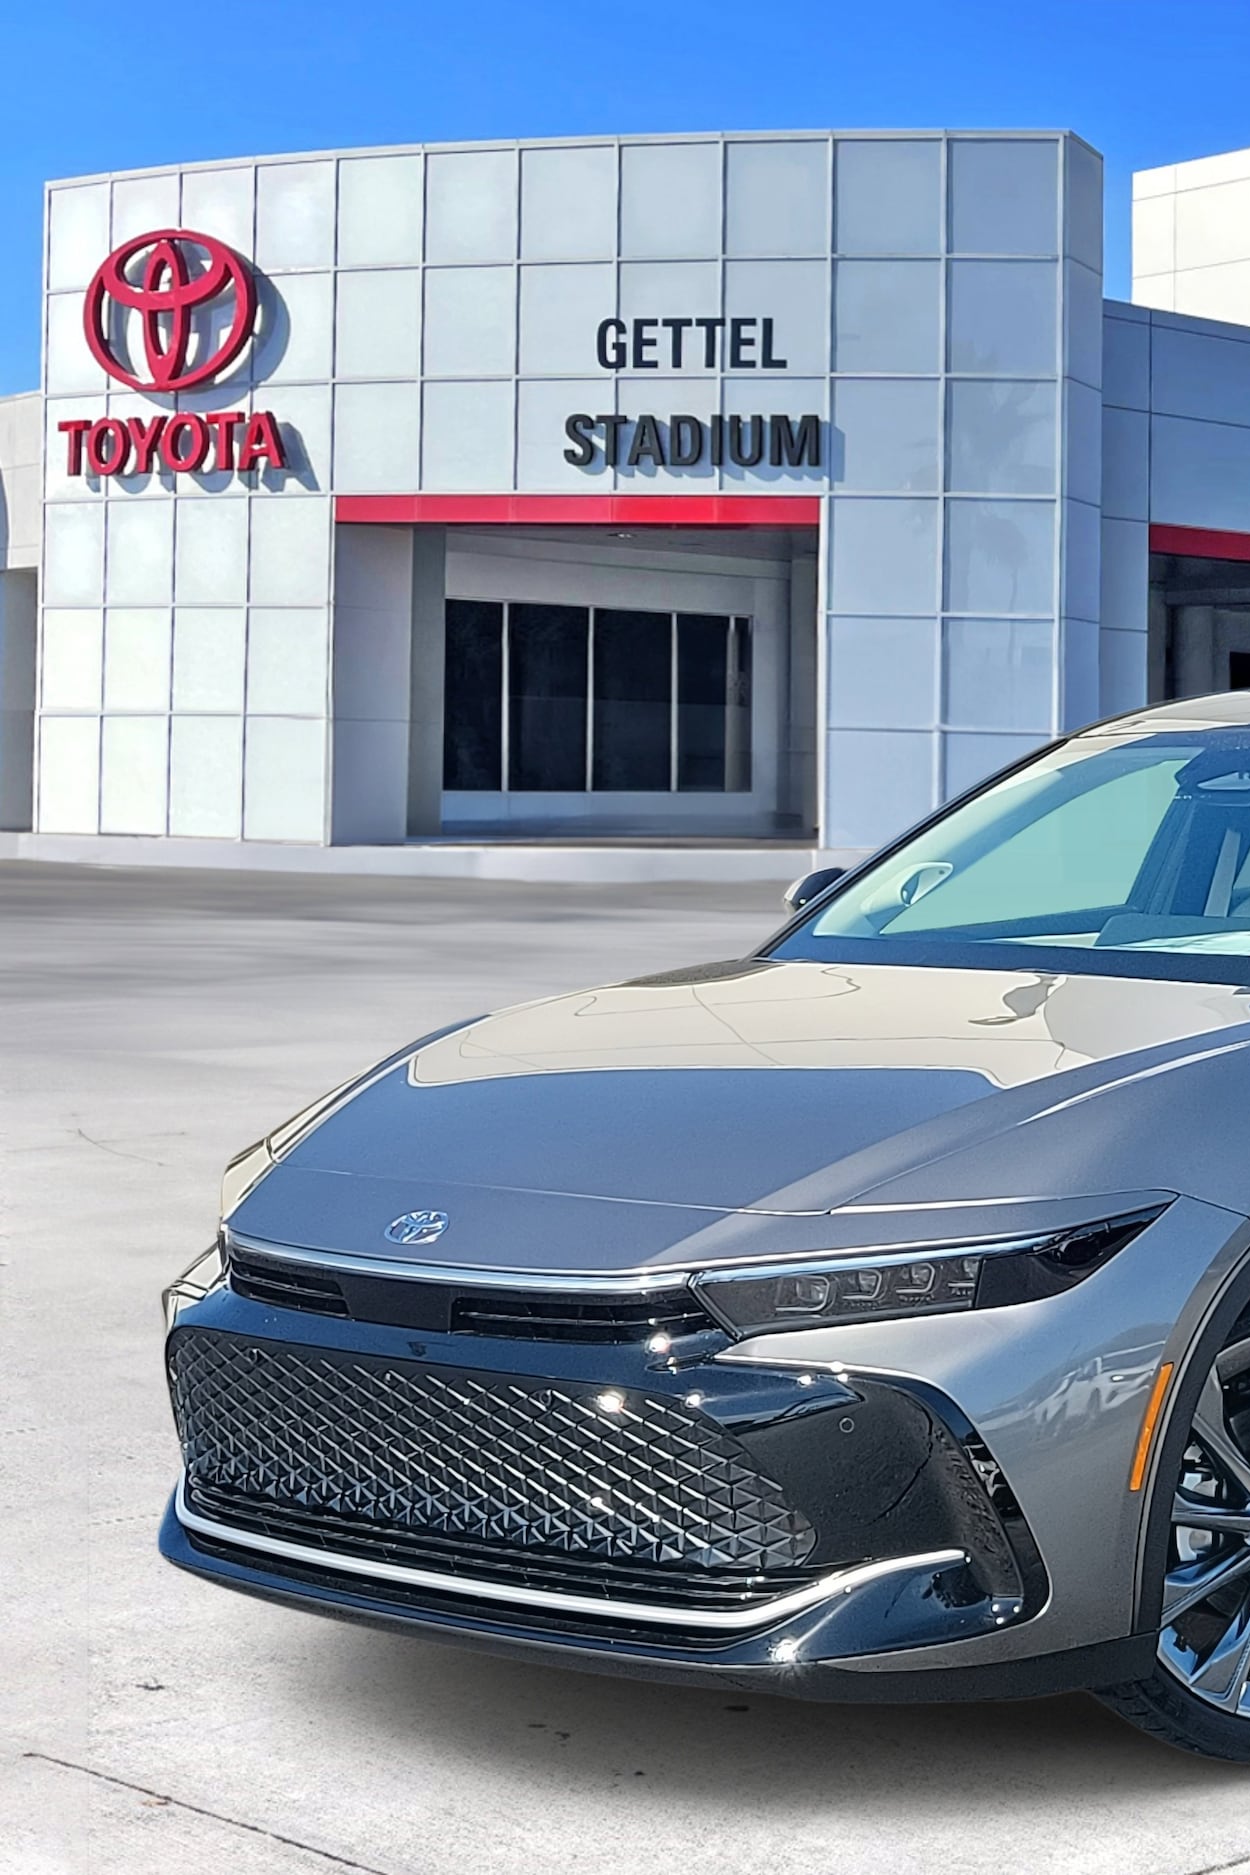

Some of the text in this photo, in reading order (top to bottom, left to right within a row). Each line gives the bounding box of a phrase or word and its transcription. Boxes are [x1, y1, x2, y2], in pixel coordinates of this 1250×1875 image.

[597, 317, 788, 369] GETTEL
[57, 410, 285, 476] TOYOTA
[563, 413, 821, 466] STADIUM
